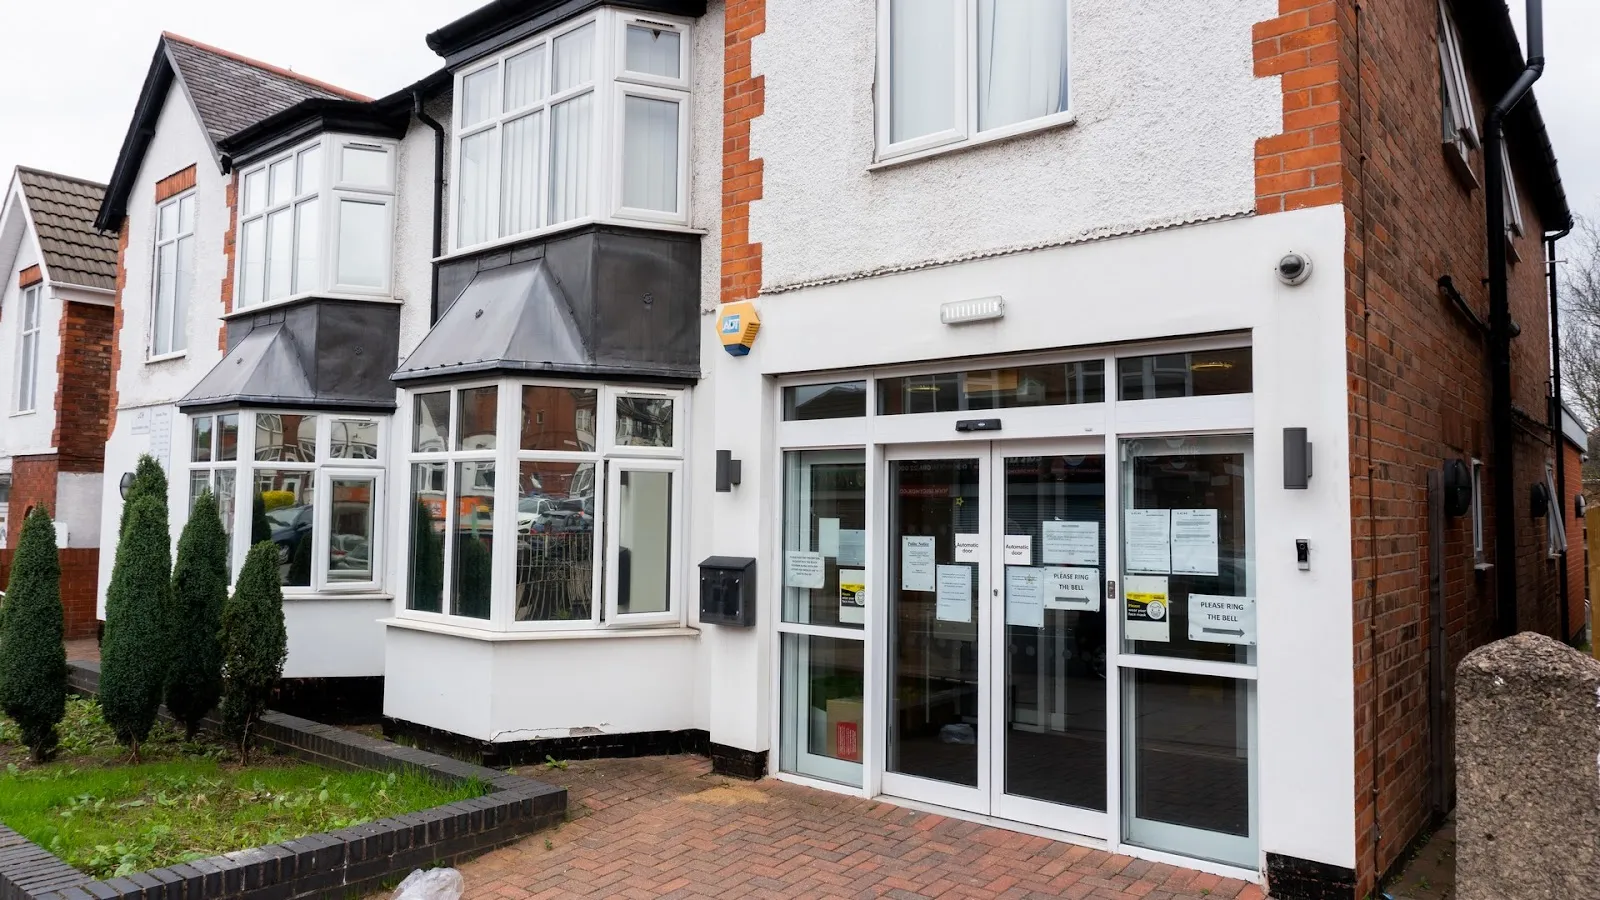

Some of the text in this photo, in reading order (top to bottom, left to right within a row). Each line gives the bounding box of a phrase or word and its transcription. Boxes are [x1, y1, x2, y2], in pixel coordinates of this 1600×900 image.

[722, 319, 739, 331] ADT
[1200, 602, 1244, 611] PLEASE RING
[1207, 613, 1238, 622] THE BELL
